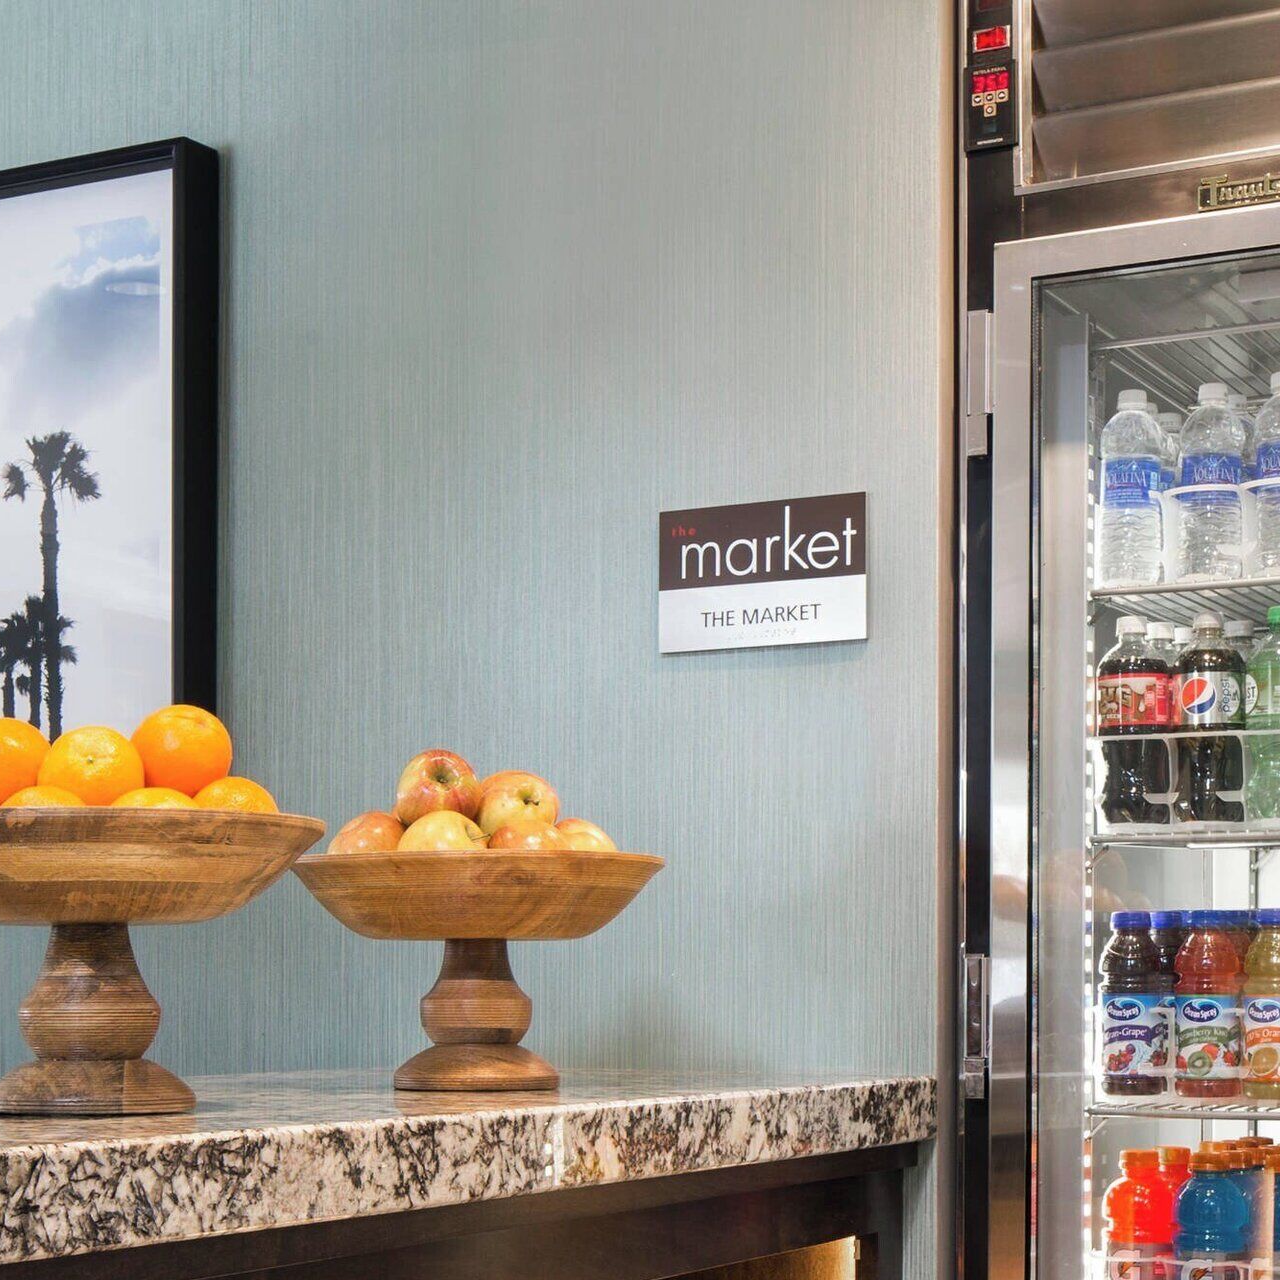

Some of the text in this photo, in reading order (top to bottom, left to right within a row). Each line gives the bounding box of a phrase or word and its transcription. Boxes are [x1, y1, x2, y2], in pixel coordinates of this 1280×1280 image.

[681, 505, 857, 579] market
[701, 603, 821, 628] THE MARKET
[1221, 678, 1233, 714] pepsi
